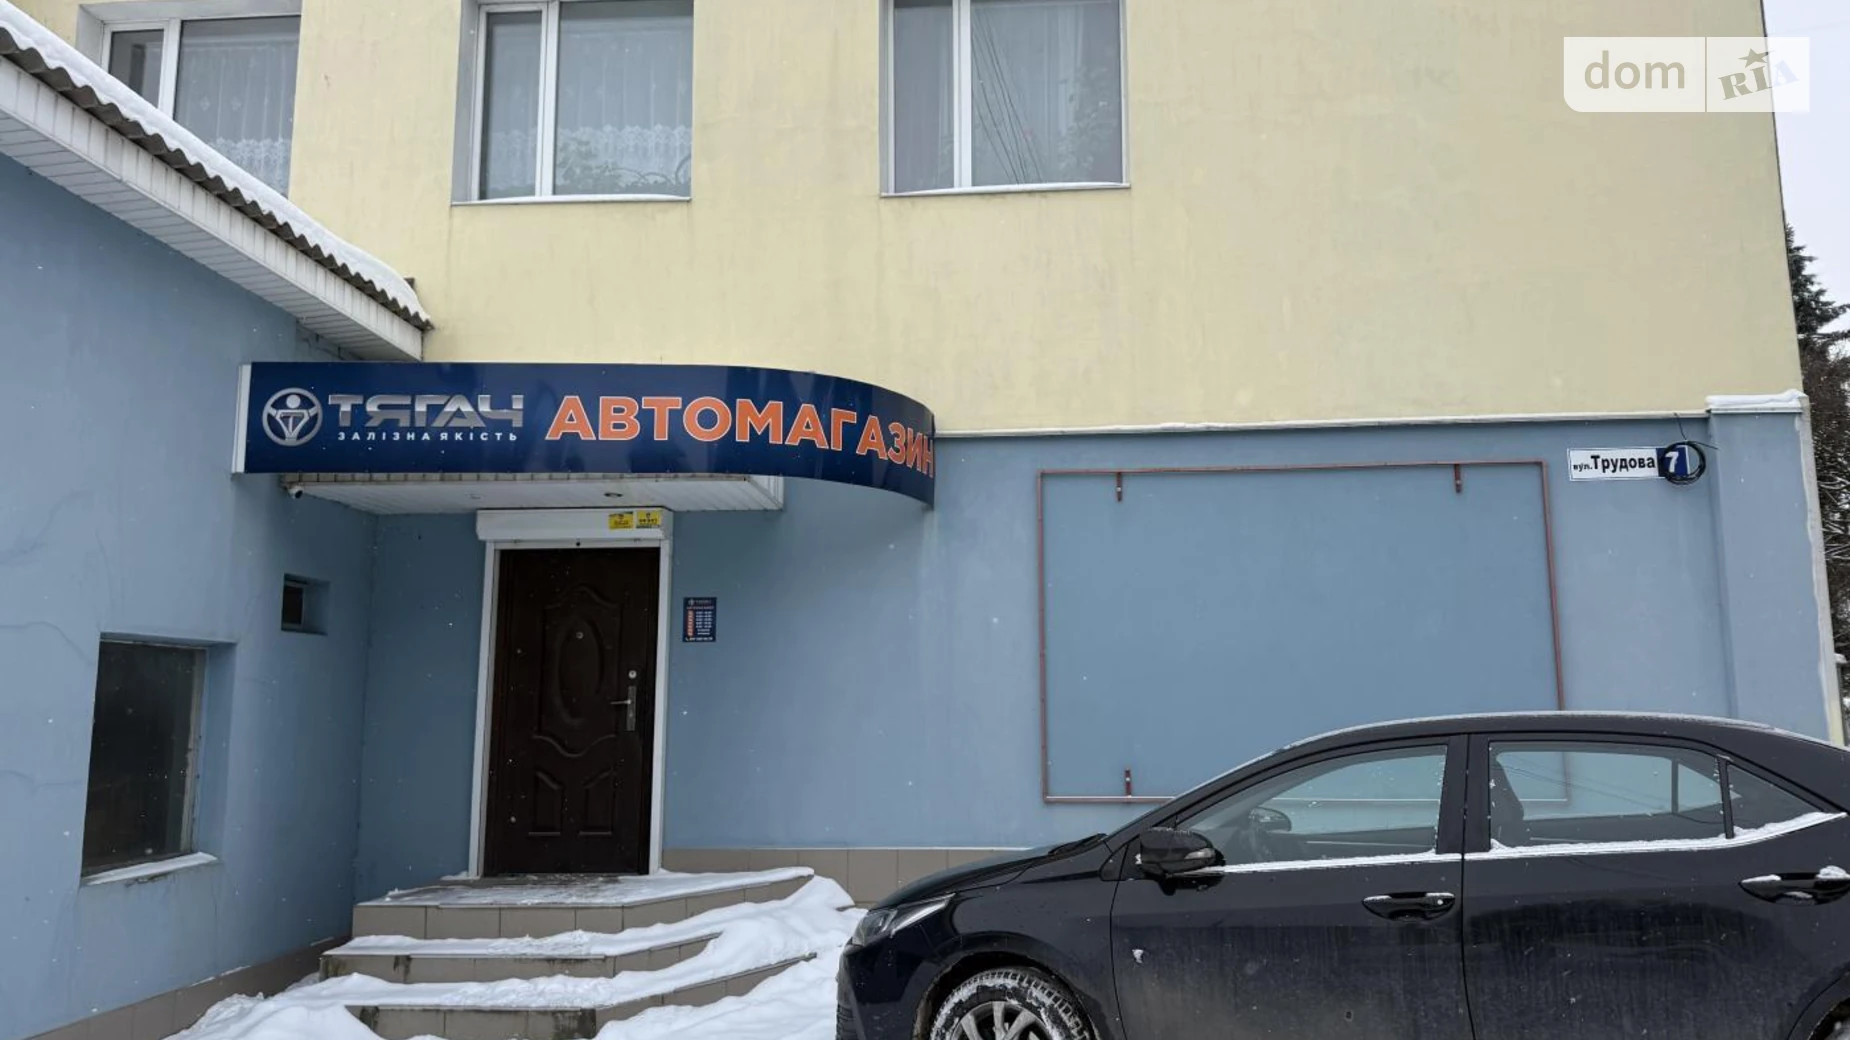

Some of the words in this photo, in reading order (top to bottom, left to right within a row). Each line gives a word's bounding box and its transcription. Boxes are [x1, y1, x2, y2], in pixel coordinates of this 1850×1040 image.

[328, 394, 524, 428] ТЯГАЧ
[337, 431, 431, 441] ЗАЛІЗНА
[439, 431, 517, 441] ЯКІСТЬ
[545, 395, 935, 478] АВТОМАГАЗИН
[1573, 463, 1593, 472] вул.
[1590, 454, 1656, 474] Трудова
[1664, 451, 1680, 473] 7
